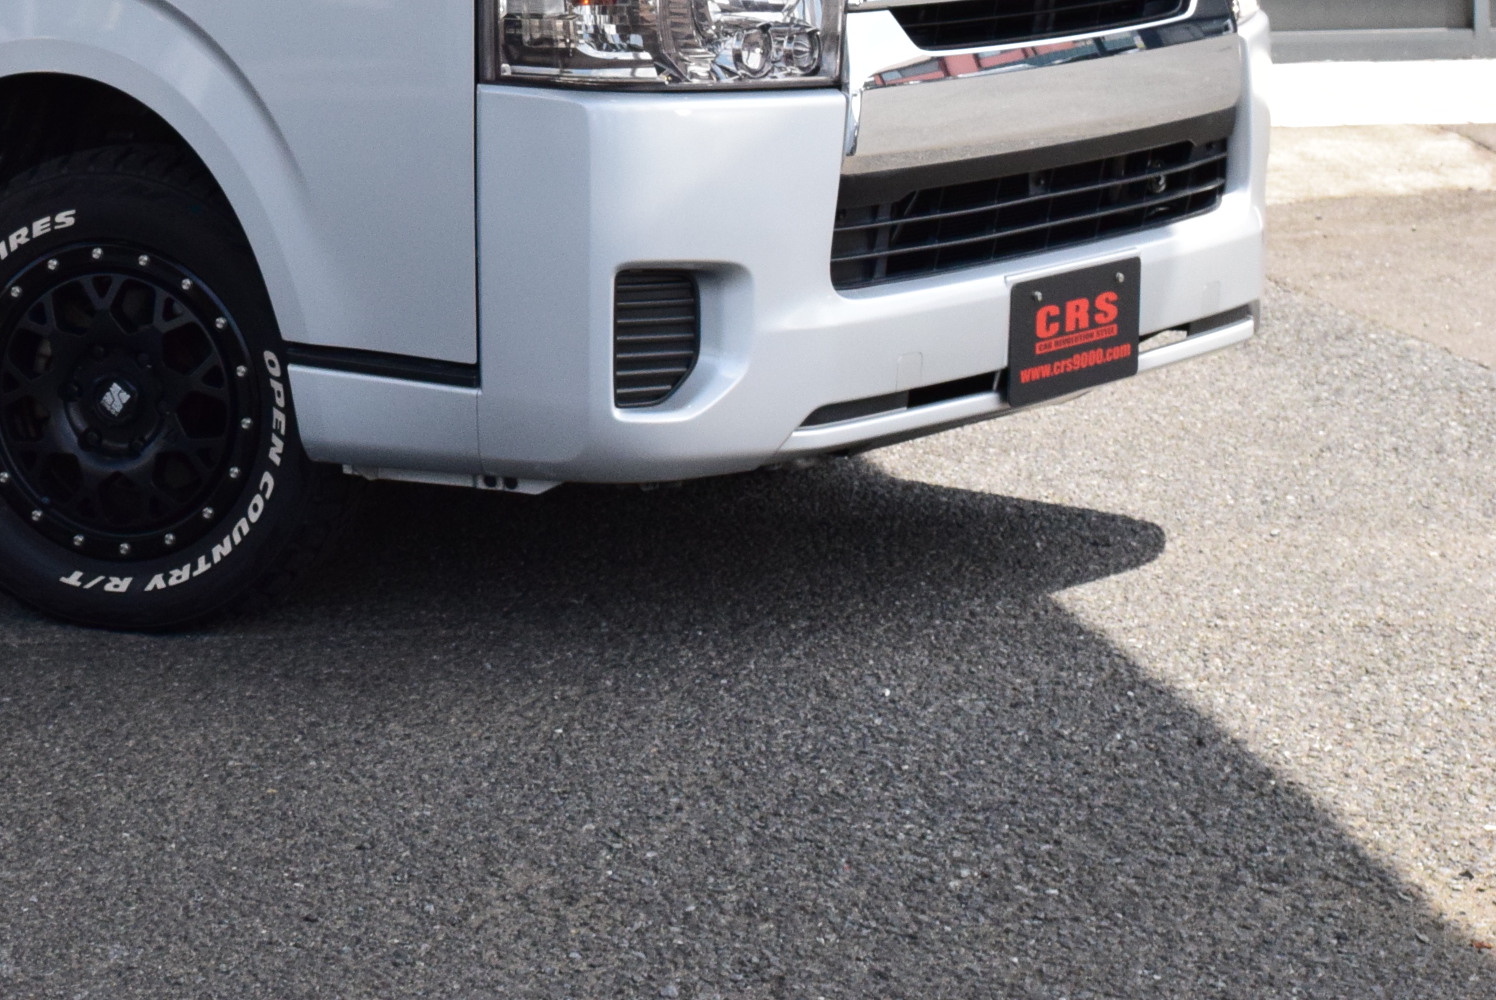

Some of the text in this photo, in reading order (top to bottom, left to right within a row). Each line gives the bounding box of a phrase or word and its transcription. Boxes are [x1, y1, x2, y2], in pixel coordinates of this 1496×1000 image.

[1035, 291, 1119, 339] CRS
[1020, 343, 1132, 384] www.crs9000.com
[59, 350, 286, 593] OPEN COUNTRY R/T
